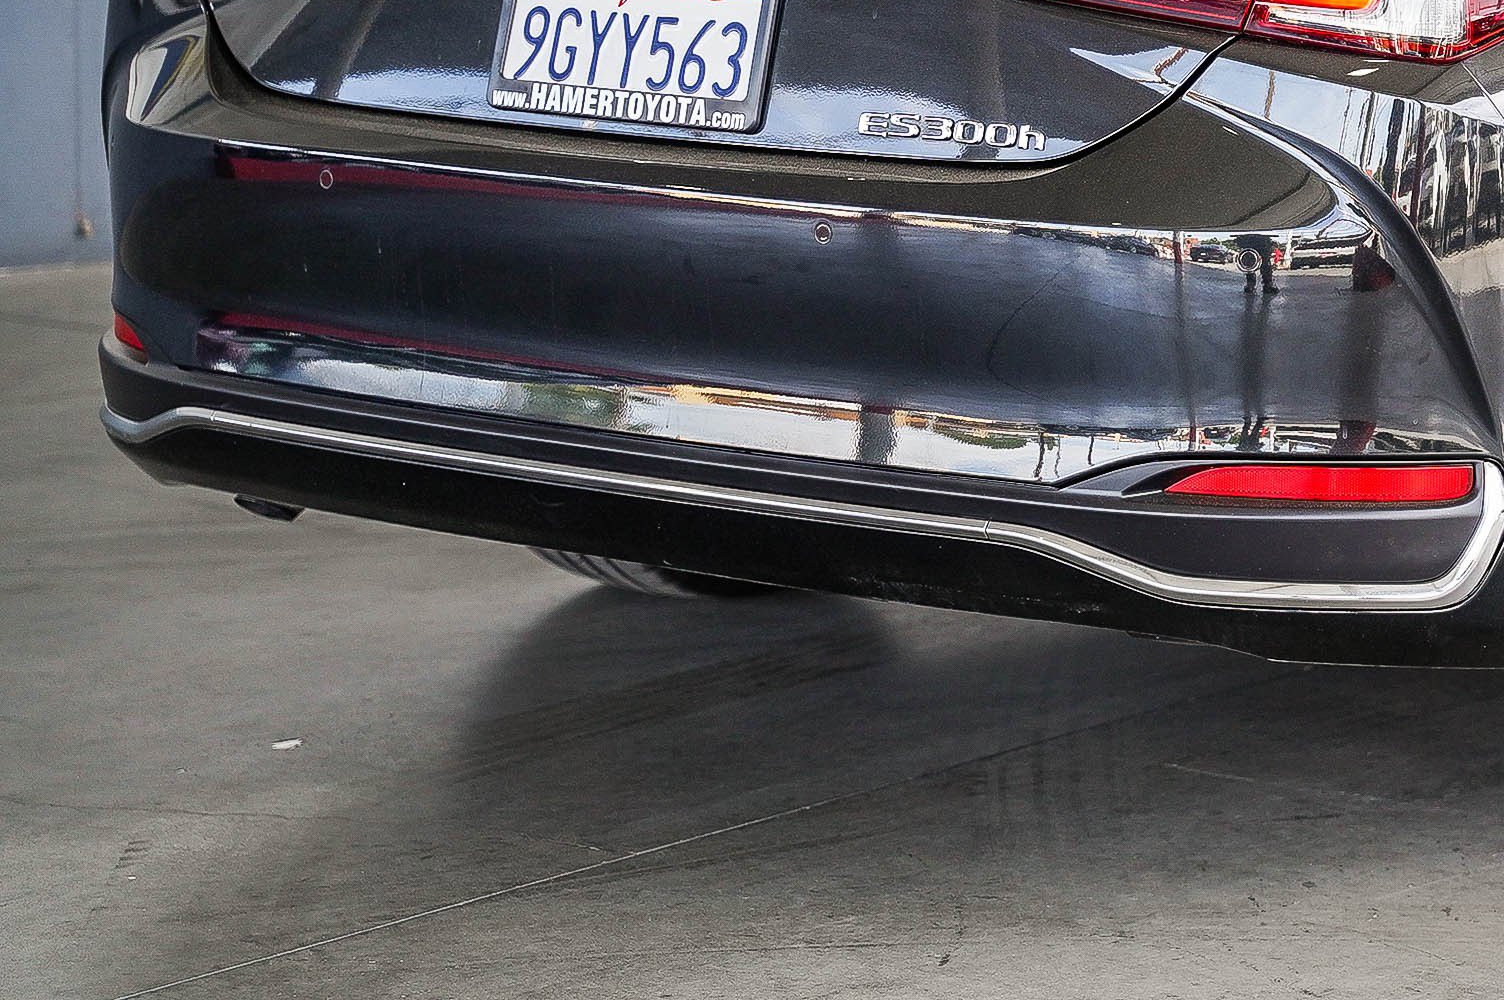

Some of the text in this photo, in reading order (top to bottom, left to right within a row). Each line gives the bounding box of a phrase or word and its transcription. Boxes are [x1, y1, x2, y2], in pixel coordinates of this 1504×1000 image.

[513, 5, 748, 98] 9GYY563
[492, 82, 746, 131] www.HAMERTOYOTA.com
[858, 111, 1047, 151] ES300h
